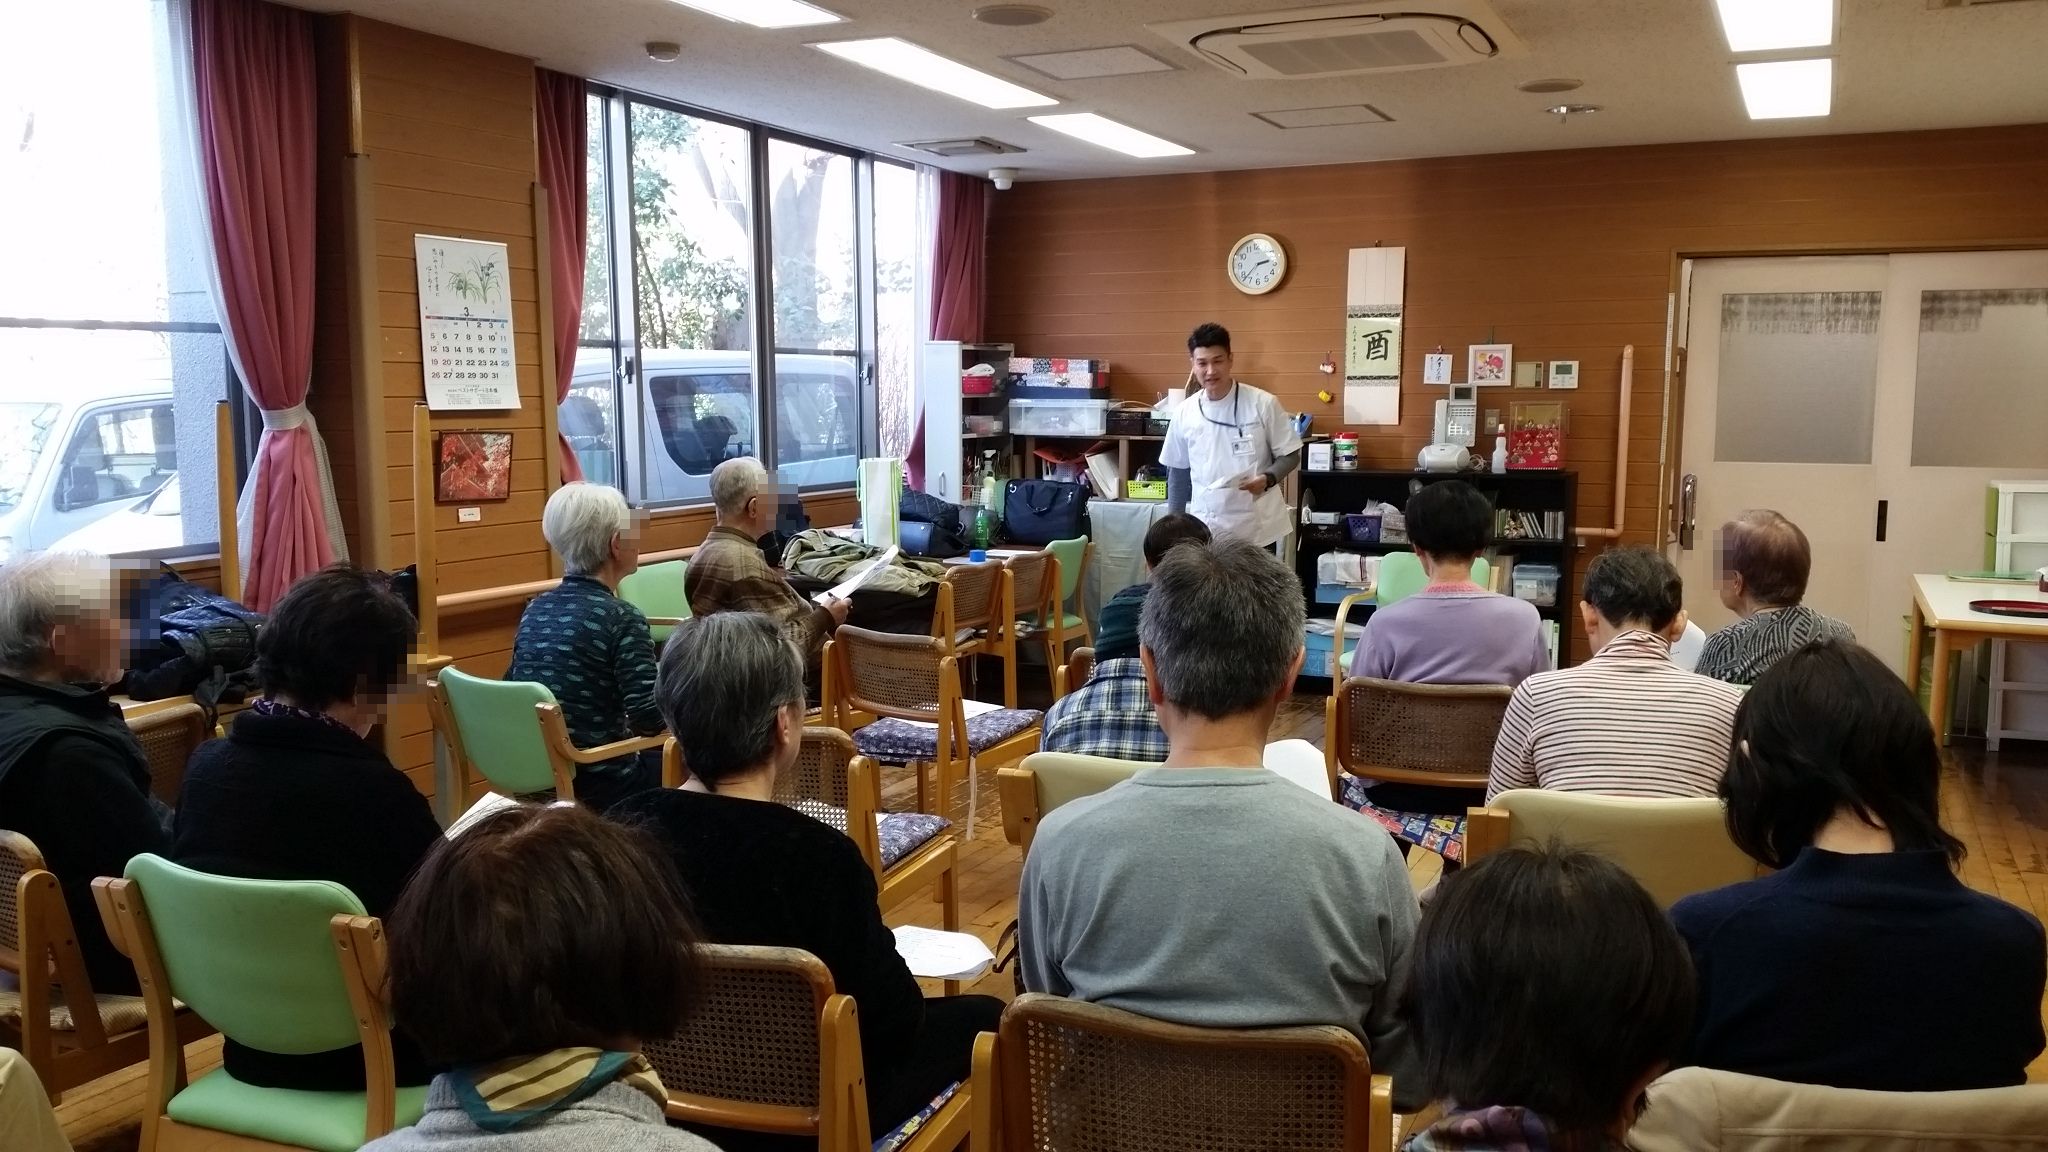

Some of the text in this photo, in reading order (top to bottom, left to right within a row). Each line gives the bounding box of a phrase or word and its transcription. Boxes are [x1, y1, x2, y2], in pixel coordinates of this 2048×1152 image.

[1238, 262, 1243, 270] 9
[464, 307, 469, 316] 3
[1361, 329, 1393, 361] 酉
